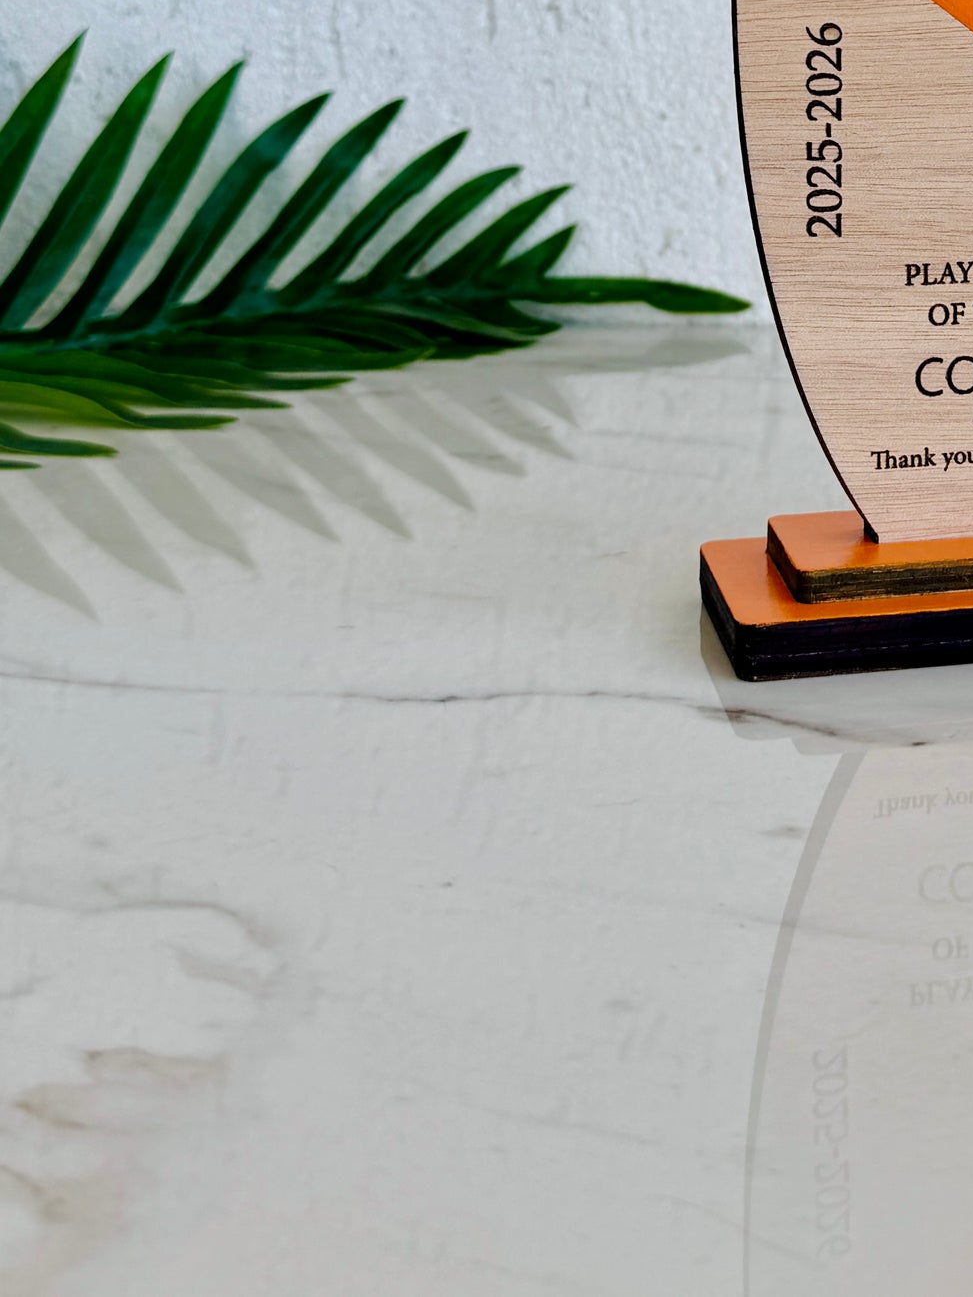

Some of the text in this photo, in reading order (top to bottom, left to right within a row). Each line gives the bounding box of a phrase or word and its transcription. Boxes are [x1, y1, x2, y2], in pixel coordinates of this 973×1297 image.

[805, 22, 844, 238] 2025-2026
[927, 302, 966, 327] OF
[870, 446, 937, 470] Thank
